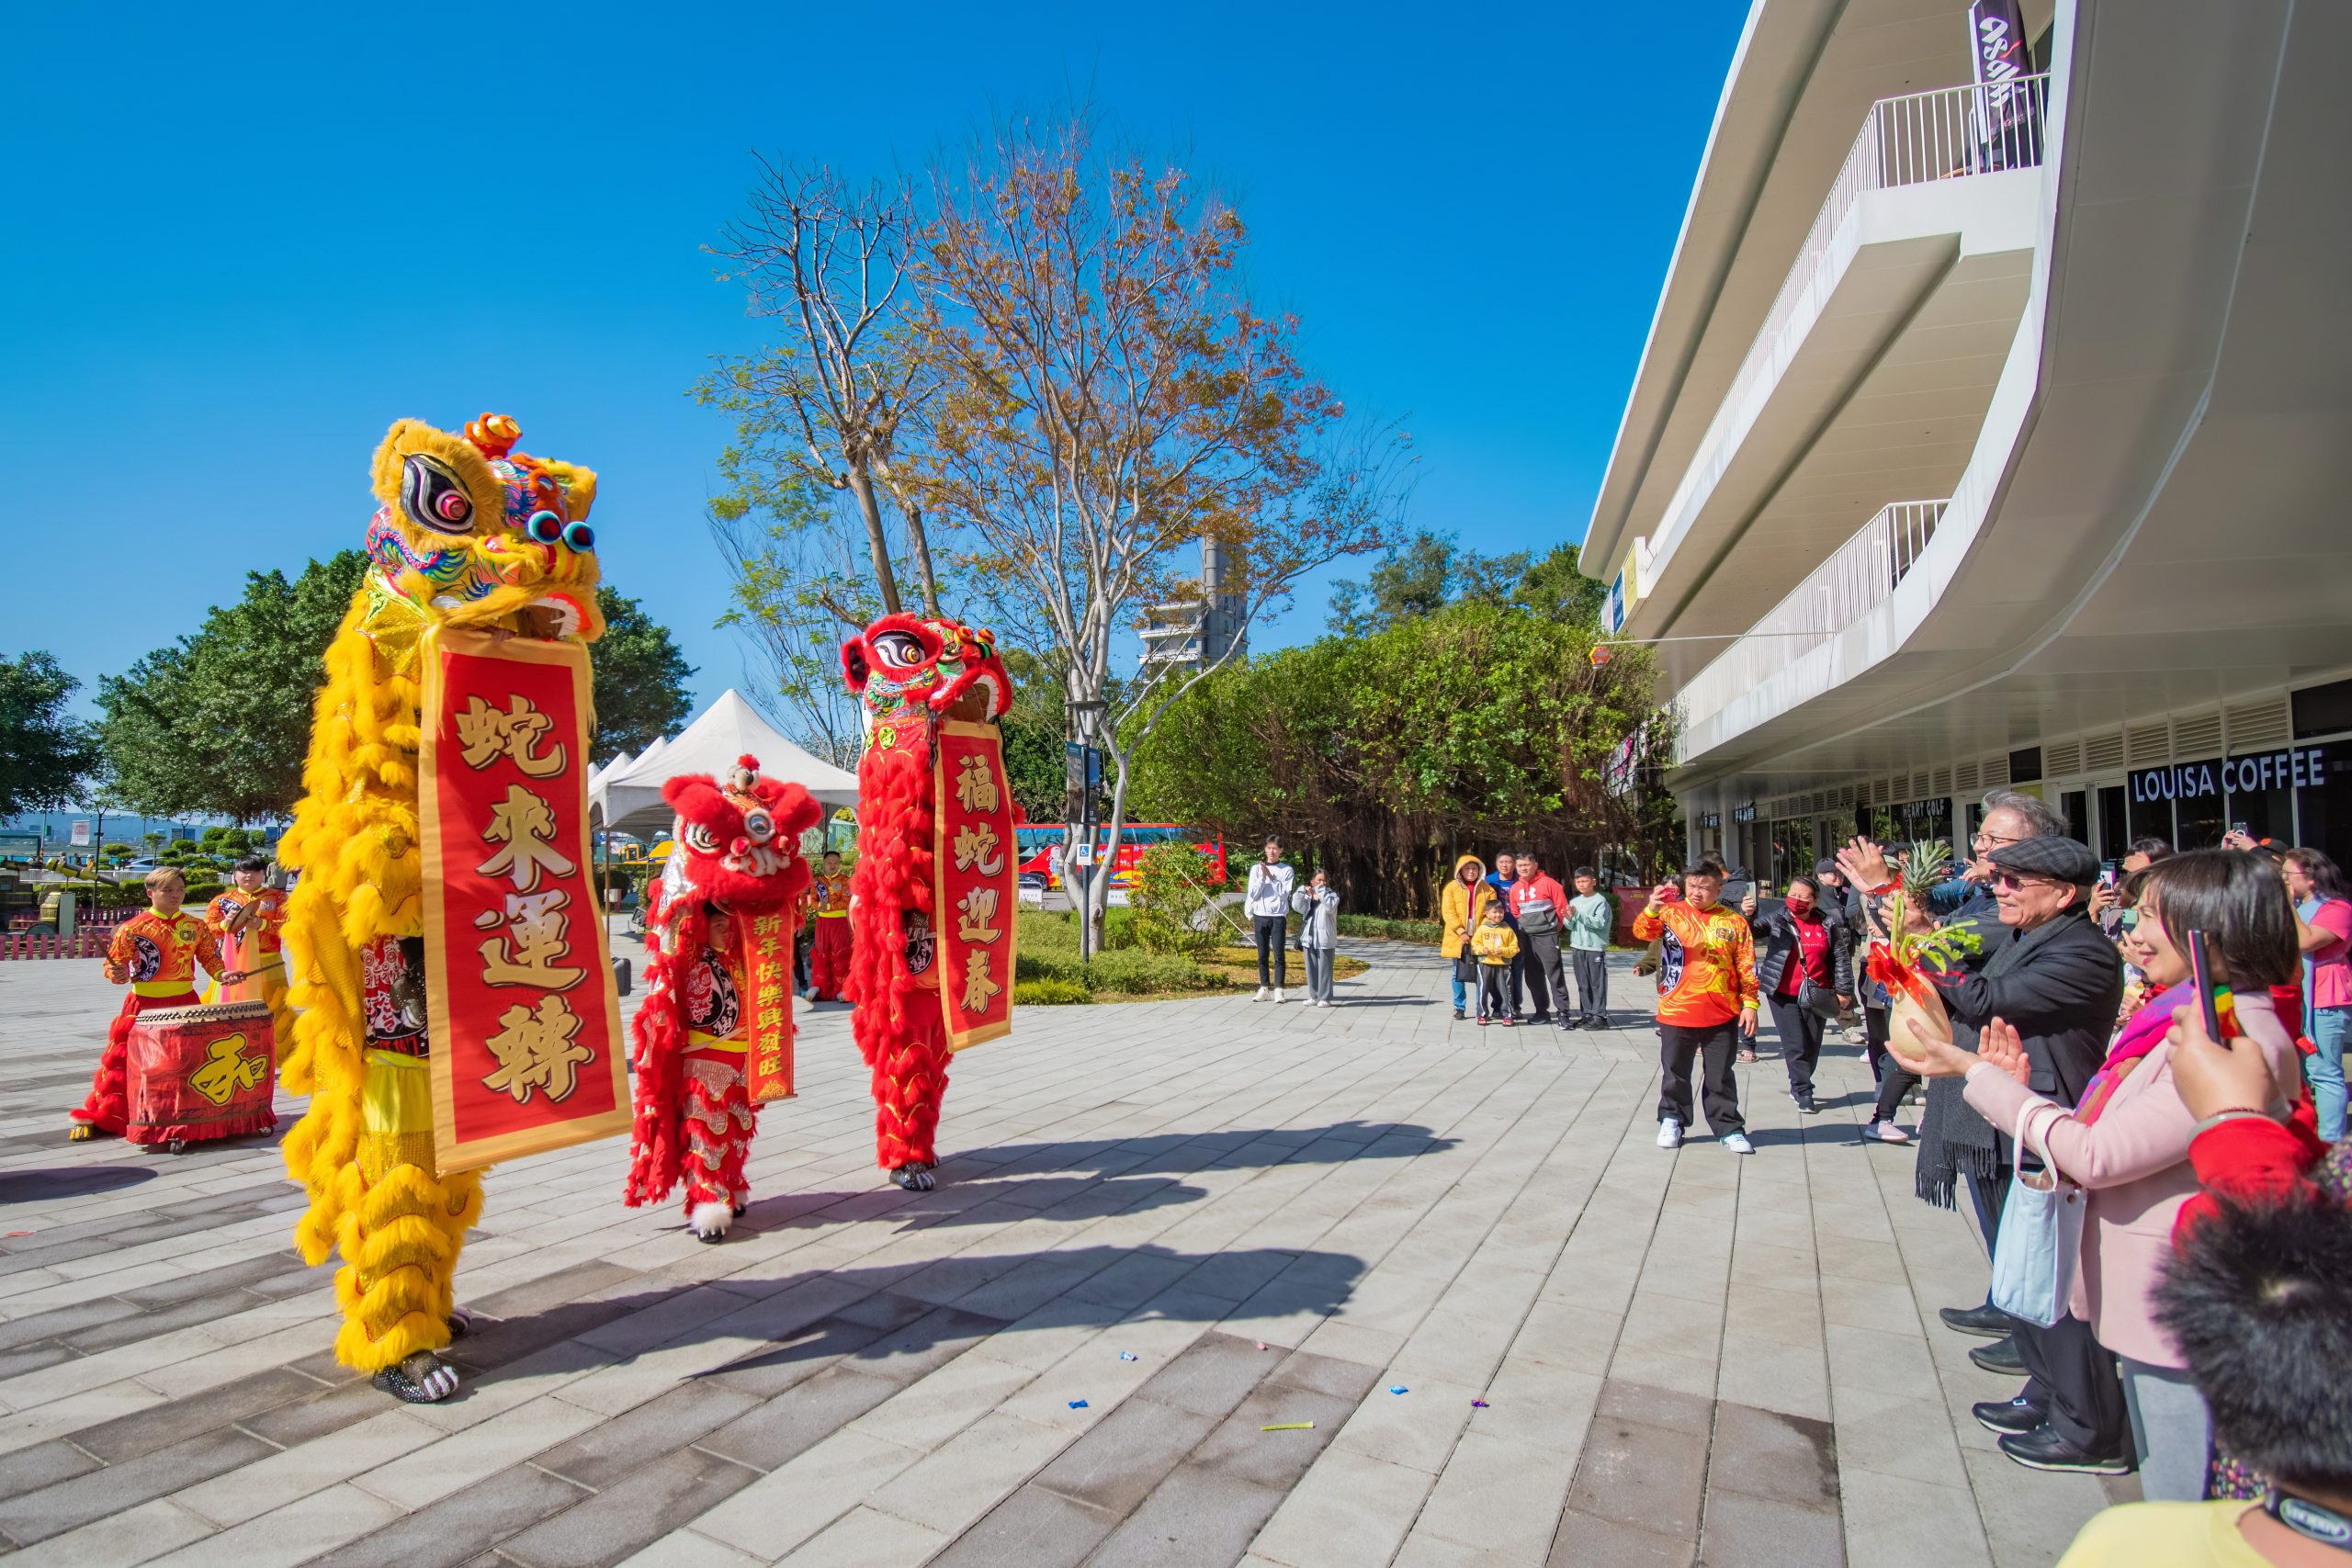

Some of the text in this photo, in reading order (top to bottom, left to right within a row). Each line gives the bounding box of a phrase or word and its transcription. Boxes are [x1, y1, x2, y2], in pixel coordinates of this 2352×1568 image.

[1902, 798, 1944, 818] HEART GOLF
[2134, 750, 2324, 802] LOUISA COFFEE
[456, 693, 595, 1104] 蛇來運轉
[955, 754, 1004, 1014] 福蛇迎春
[752, 914, 785, 1077] 新年快樂興發旺
